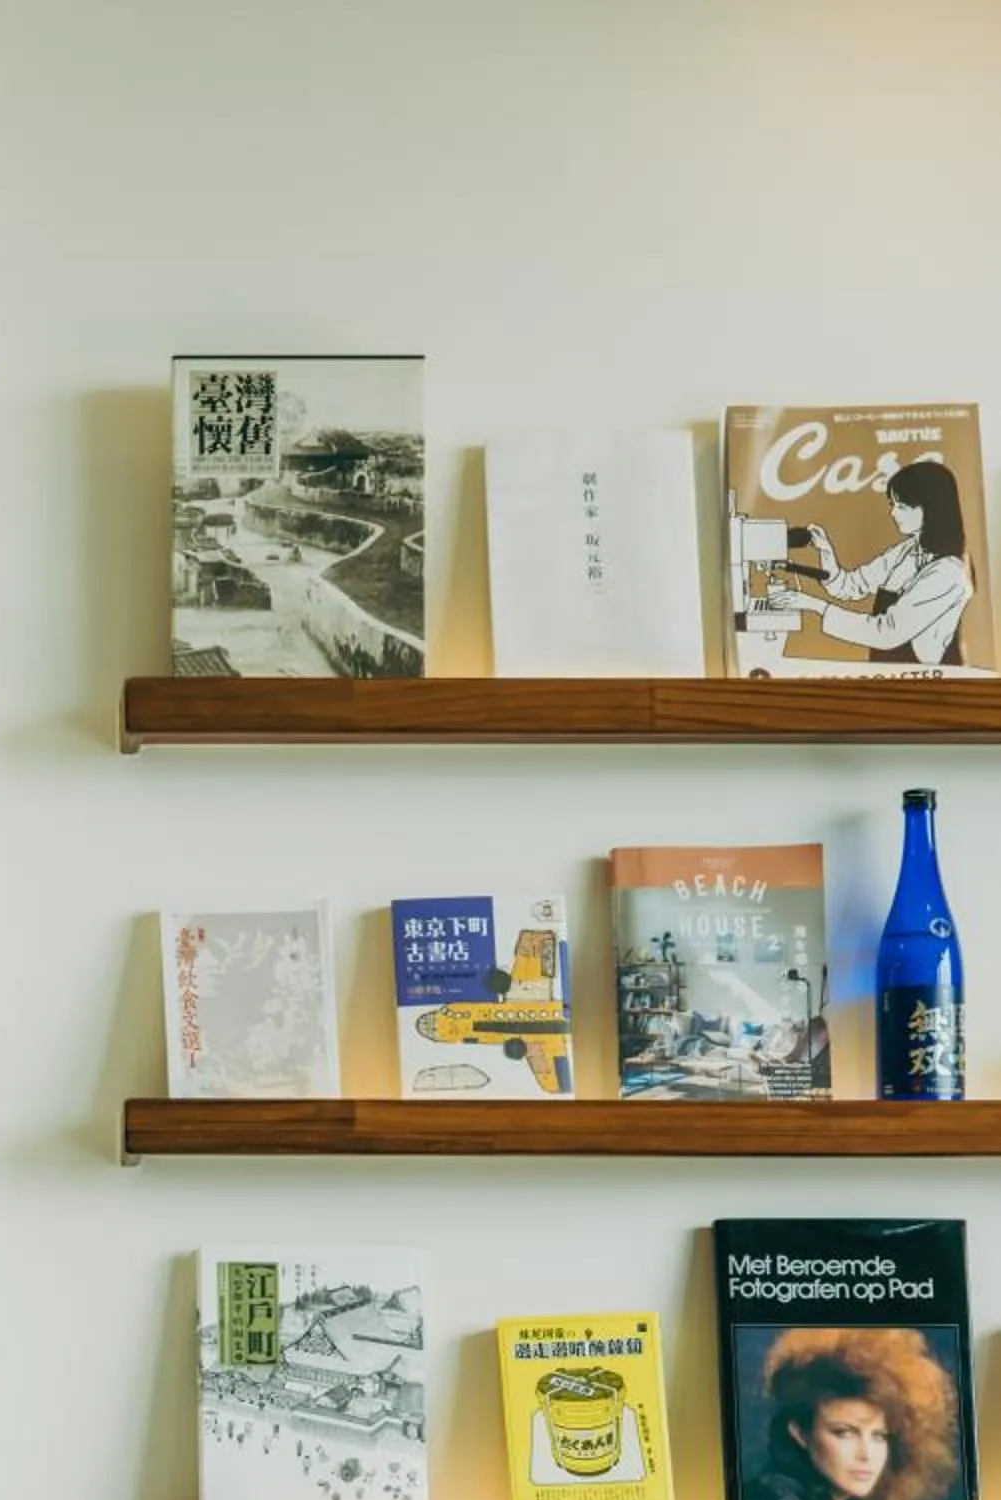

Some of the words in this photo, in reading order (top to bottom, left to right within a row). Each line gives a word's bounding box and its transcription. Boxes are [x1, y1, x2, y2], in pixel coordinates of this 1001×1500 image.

[760, 421, 945, 500] Cas
[673, 873, 768, 904] BEACH
[403, 917, 489, 939] 東京下町
[680, 914, 764, 938] HOUSE
[728, 1254, 771, 1276] Met
[776, 1255, 897, 1277] Beroemde
[729, 1278, 849, 1303] Fotografen
[852, 1283, 886, 1303] op
[889, 1278, 934, 1299] Pad
